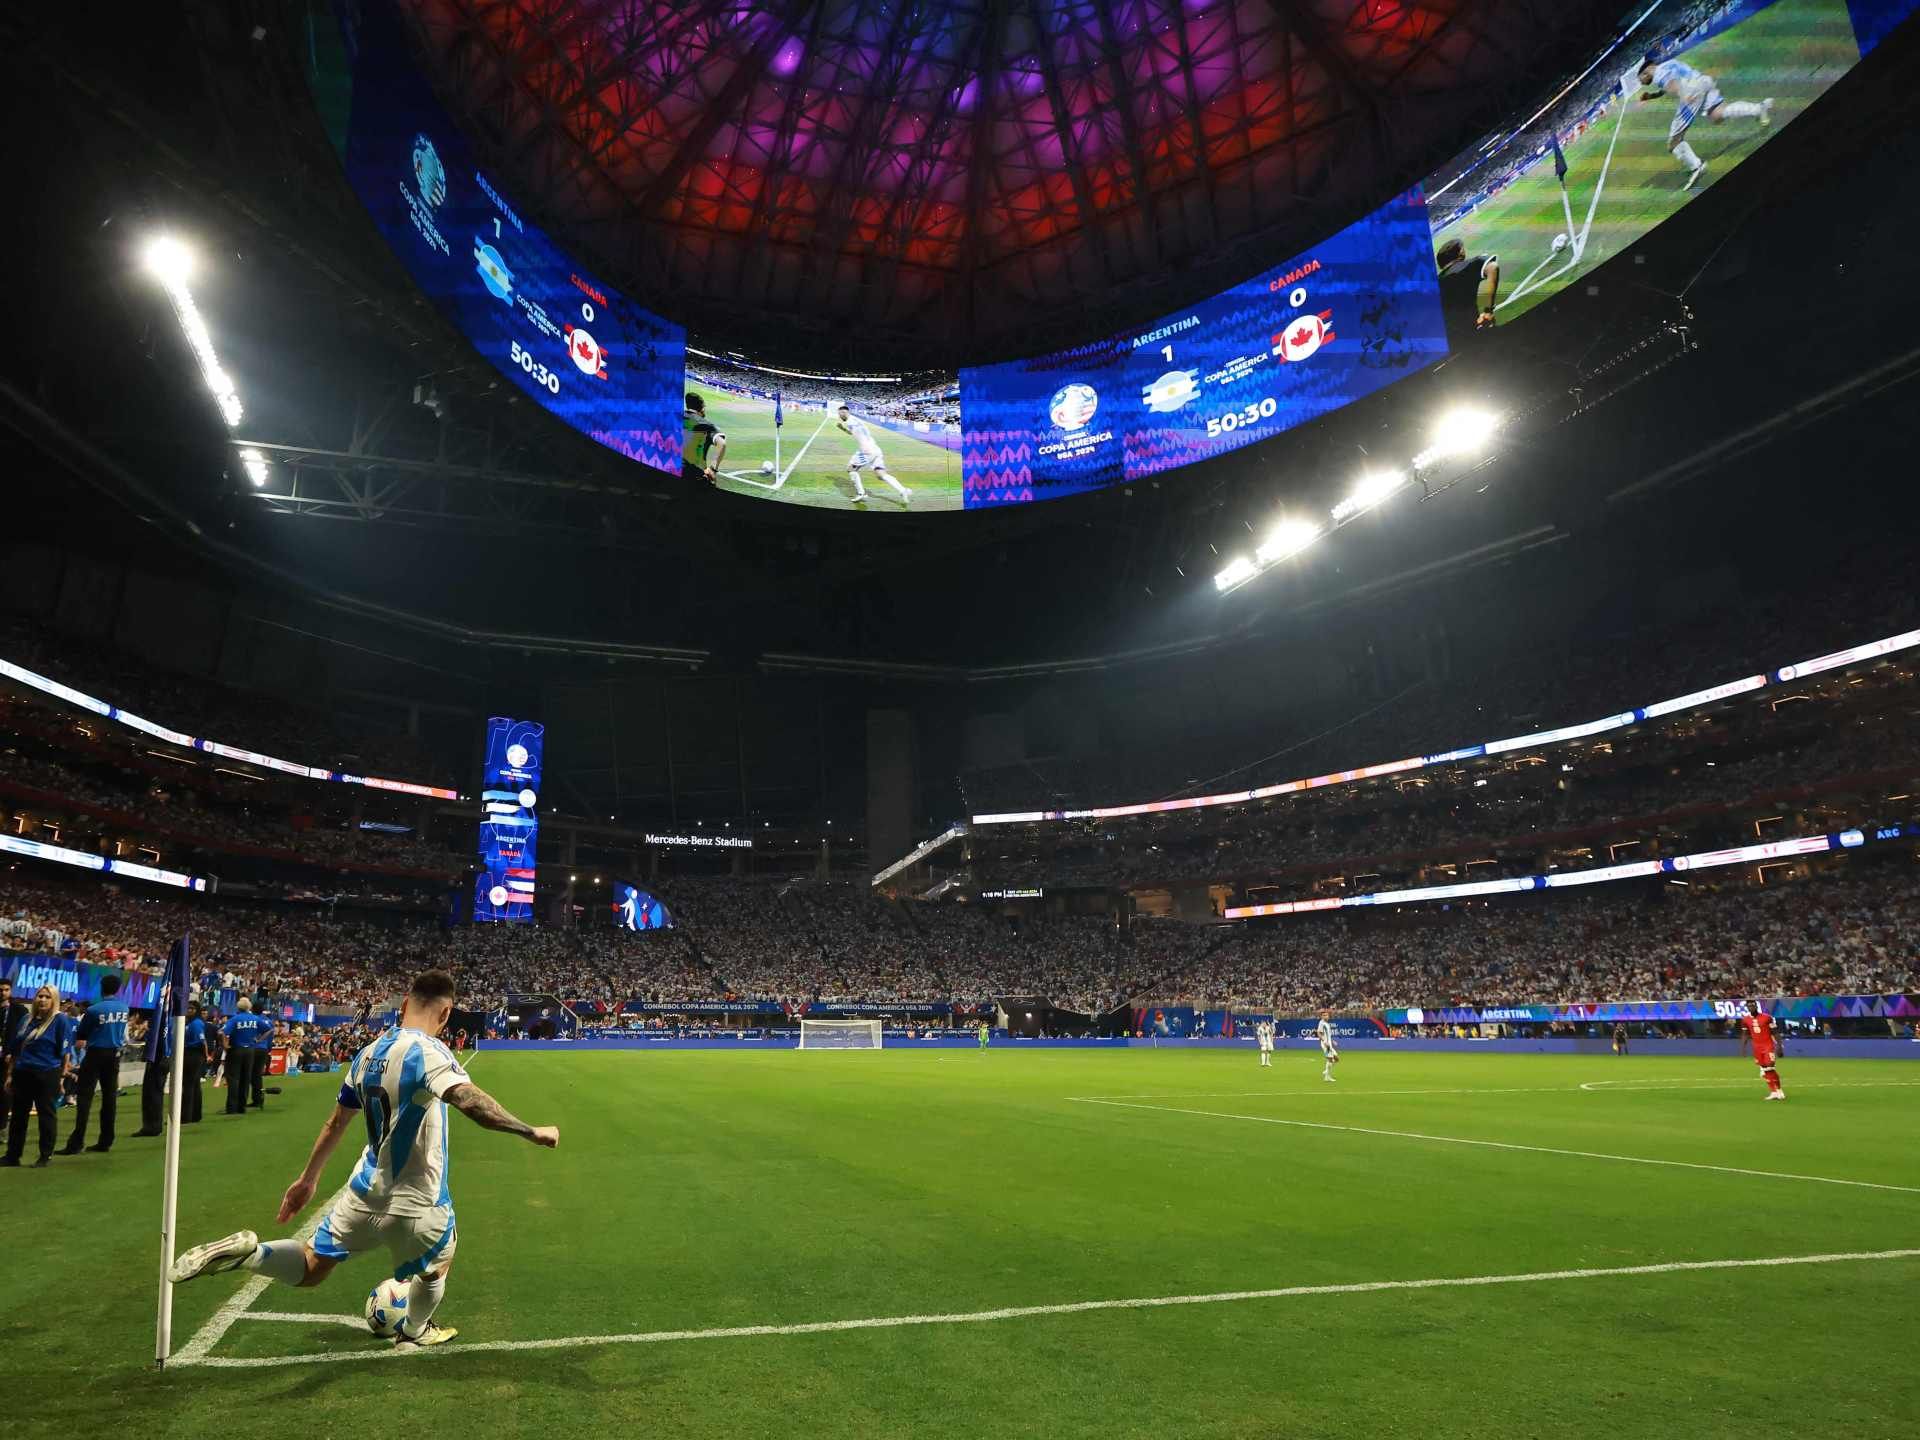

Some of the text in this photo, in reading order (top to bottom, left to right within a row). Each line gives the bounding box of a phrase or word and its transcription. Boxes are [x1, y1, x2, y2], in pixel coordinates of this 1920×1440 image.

[400, 181, 418, 213] COPA
[493, 217, 501, 239] 1
[1269, 259, 1322, 292] CANADA
[571, 273, 608, 309] CANADA
[1289, 287, 1307, 308] 0
[517, 295, 533, 313] COPA
[582, 303, 594, 322] 0
[1132, 315, 1201, 349] ARGENTINA
[1161, 345, 1173, 362] 1
[511, 340, 560, 394] 50:30
[1204, 370, 1228, 384] COPA
[1206, 397, 1278, 438] 50:30
[1038, 443, 1066, 455] COPA
[1057, 451, 1074, 460] USA
[645, 834, 752, 848] Mercedes-Benz Stadium
[17, 963, 79, 995] ARGENTINA
[1482, 1008, 1533, 1019] ARGENTINA
